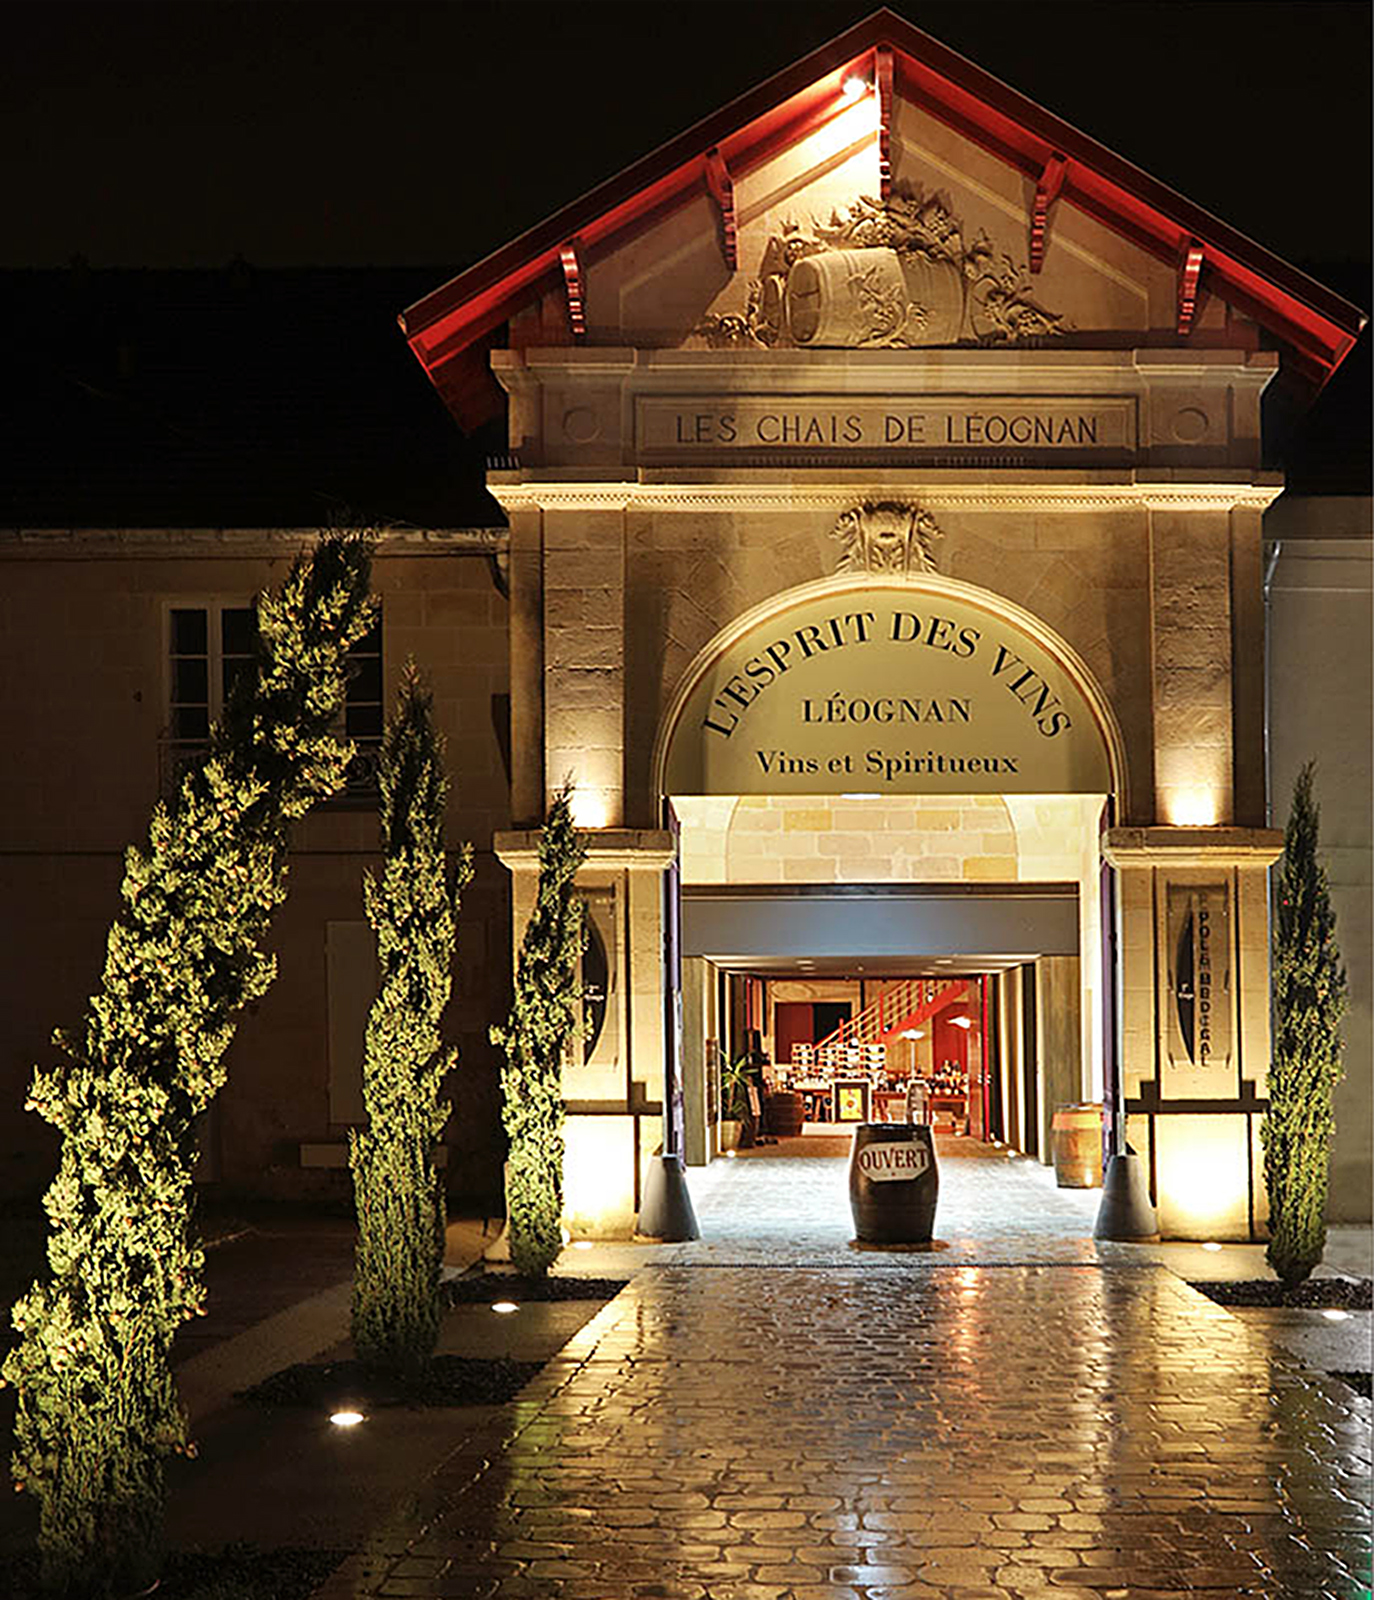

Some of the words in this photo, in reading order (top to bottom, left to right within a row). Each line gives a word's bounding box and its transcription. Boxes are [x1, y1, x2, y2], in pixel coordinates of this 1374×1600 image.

[677, 415, 736, 443] LES
[757, 415, 862, 443] CHAIS
[885, 416, 926, 443] DE
[947, 411, 1098, 443] LÉOGNAN
[703, 612, 876, 739] L'ESPRIT
[888, 612, 981, 659] DES
[990, 644, 1073, 739] VINS
[802, 692, 973, 723] LÉOGNAN
[756, 750, 818, 774] Vins
[828, 752, 853, 774] et
[866, 749, 1018, 781] Spiritueux
[859, 1147, 927, 1171] OUVERT
